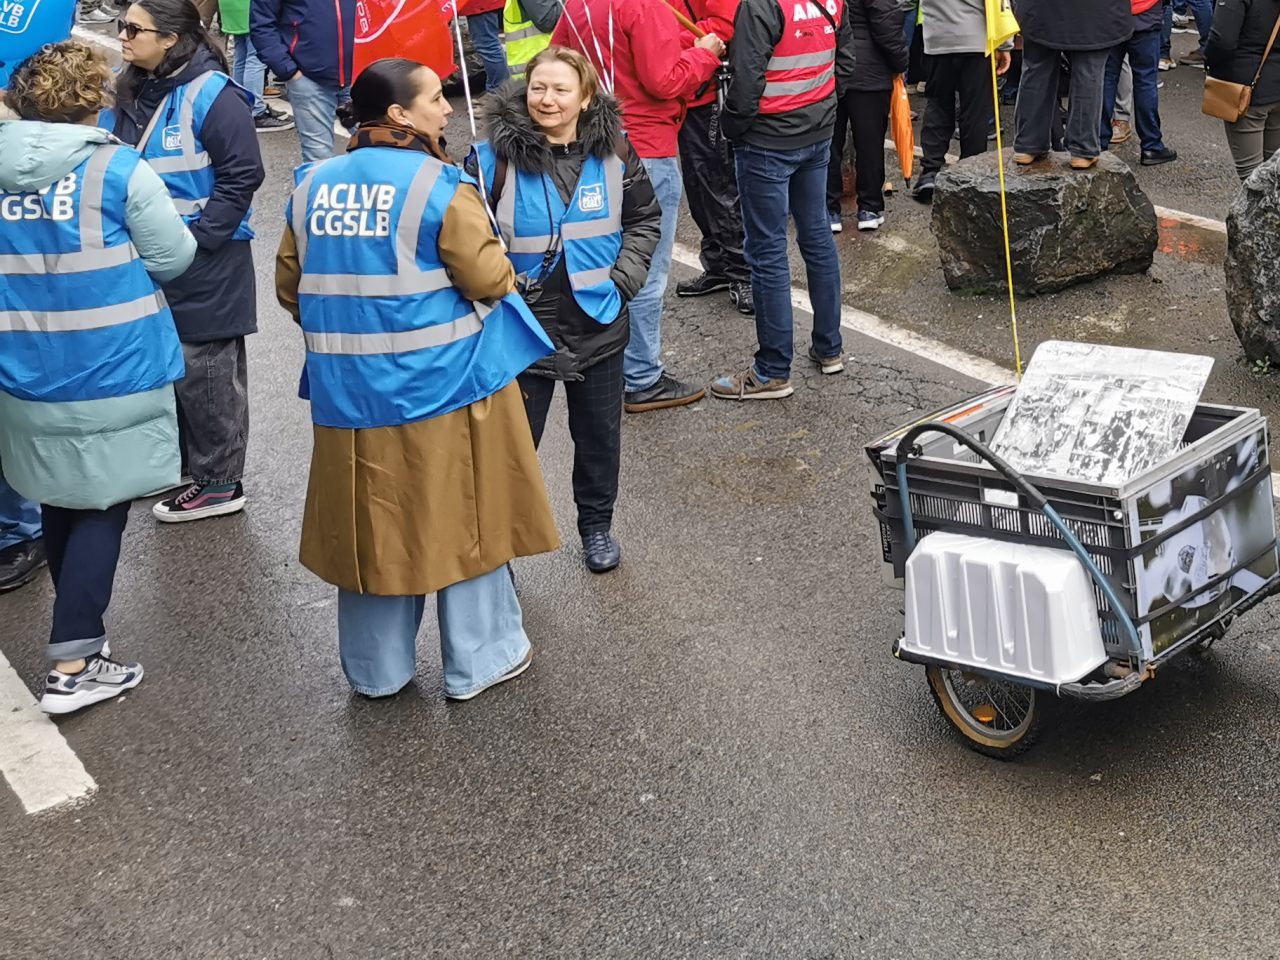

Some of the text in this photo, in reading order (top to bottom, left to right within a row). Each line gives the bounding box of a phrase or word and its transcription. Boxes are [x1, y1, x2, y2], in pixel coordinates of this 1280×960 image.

[793, 0, 837, 22] AMO
[312, 183, 396, 211] ACLVB
[311, 210, 391, 237] CGSLB
